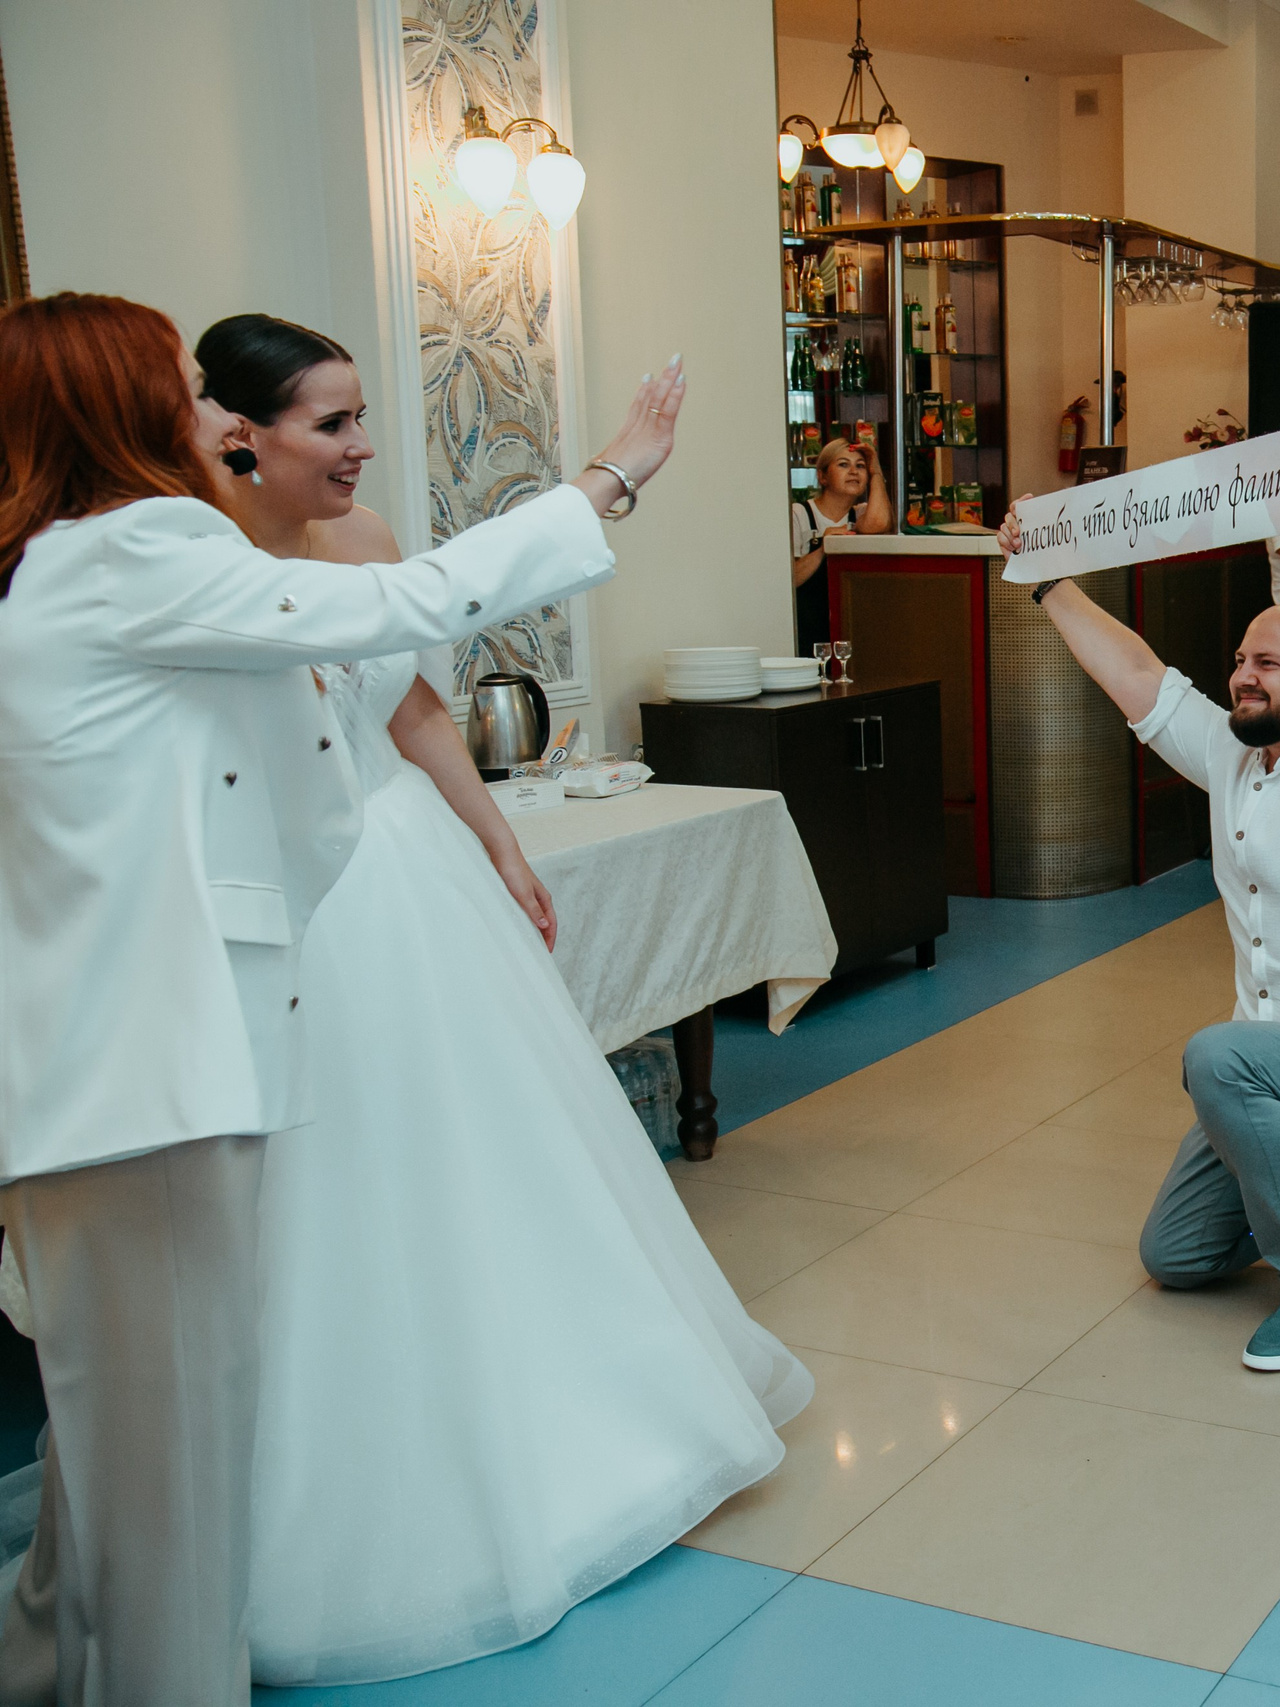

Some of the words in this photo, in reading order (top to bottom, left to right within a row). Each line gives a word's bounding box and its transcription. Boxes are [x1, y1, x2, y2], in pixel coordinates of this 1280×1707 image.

[1083, 499, 1116, 539] что
[1122, 488, 1171, 549] взяла
[1177, 483, 1220, 519] мою
